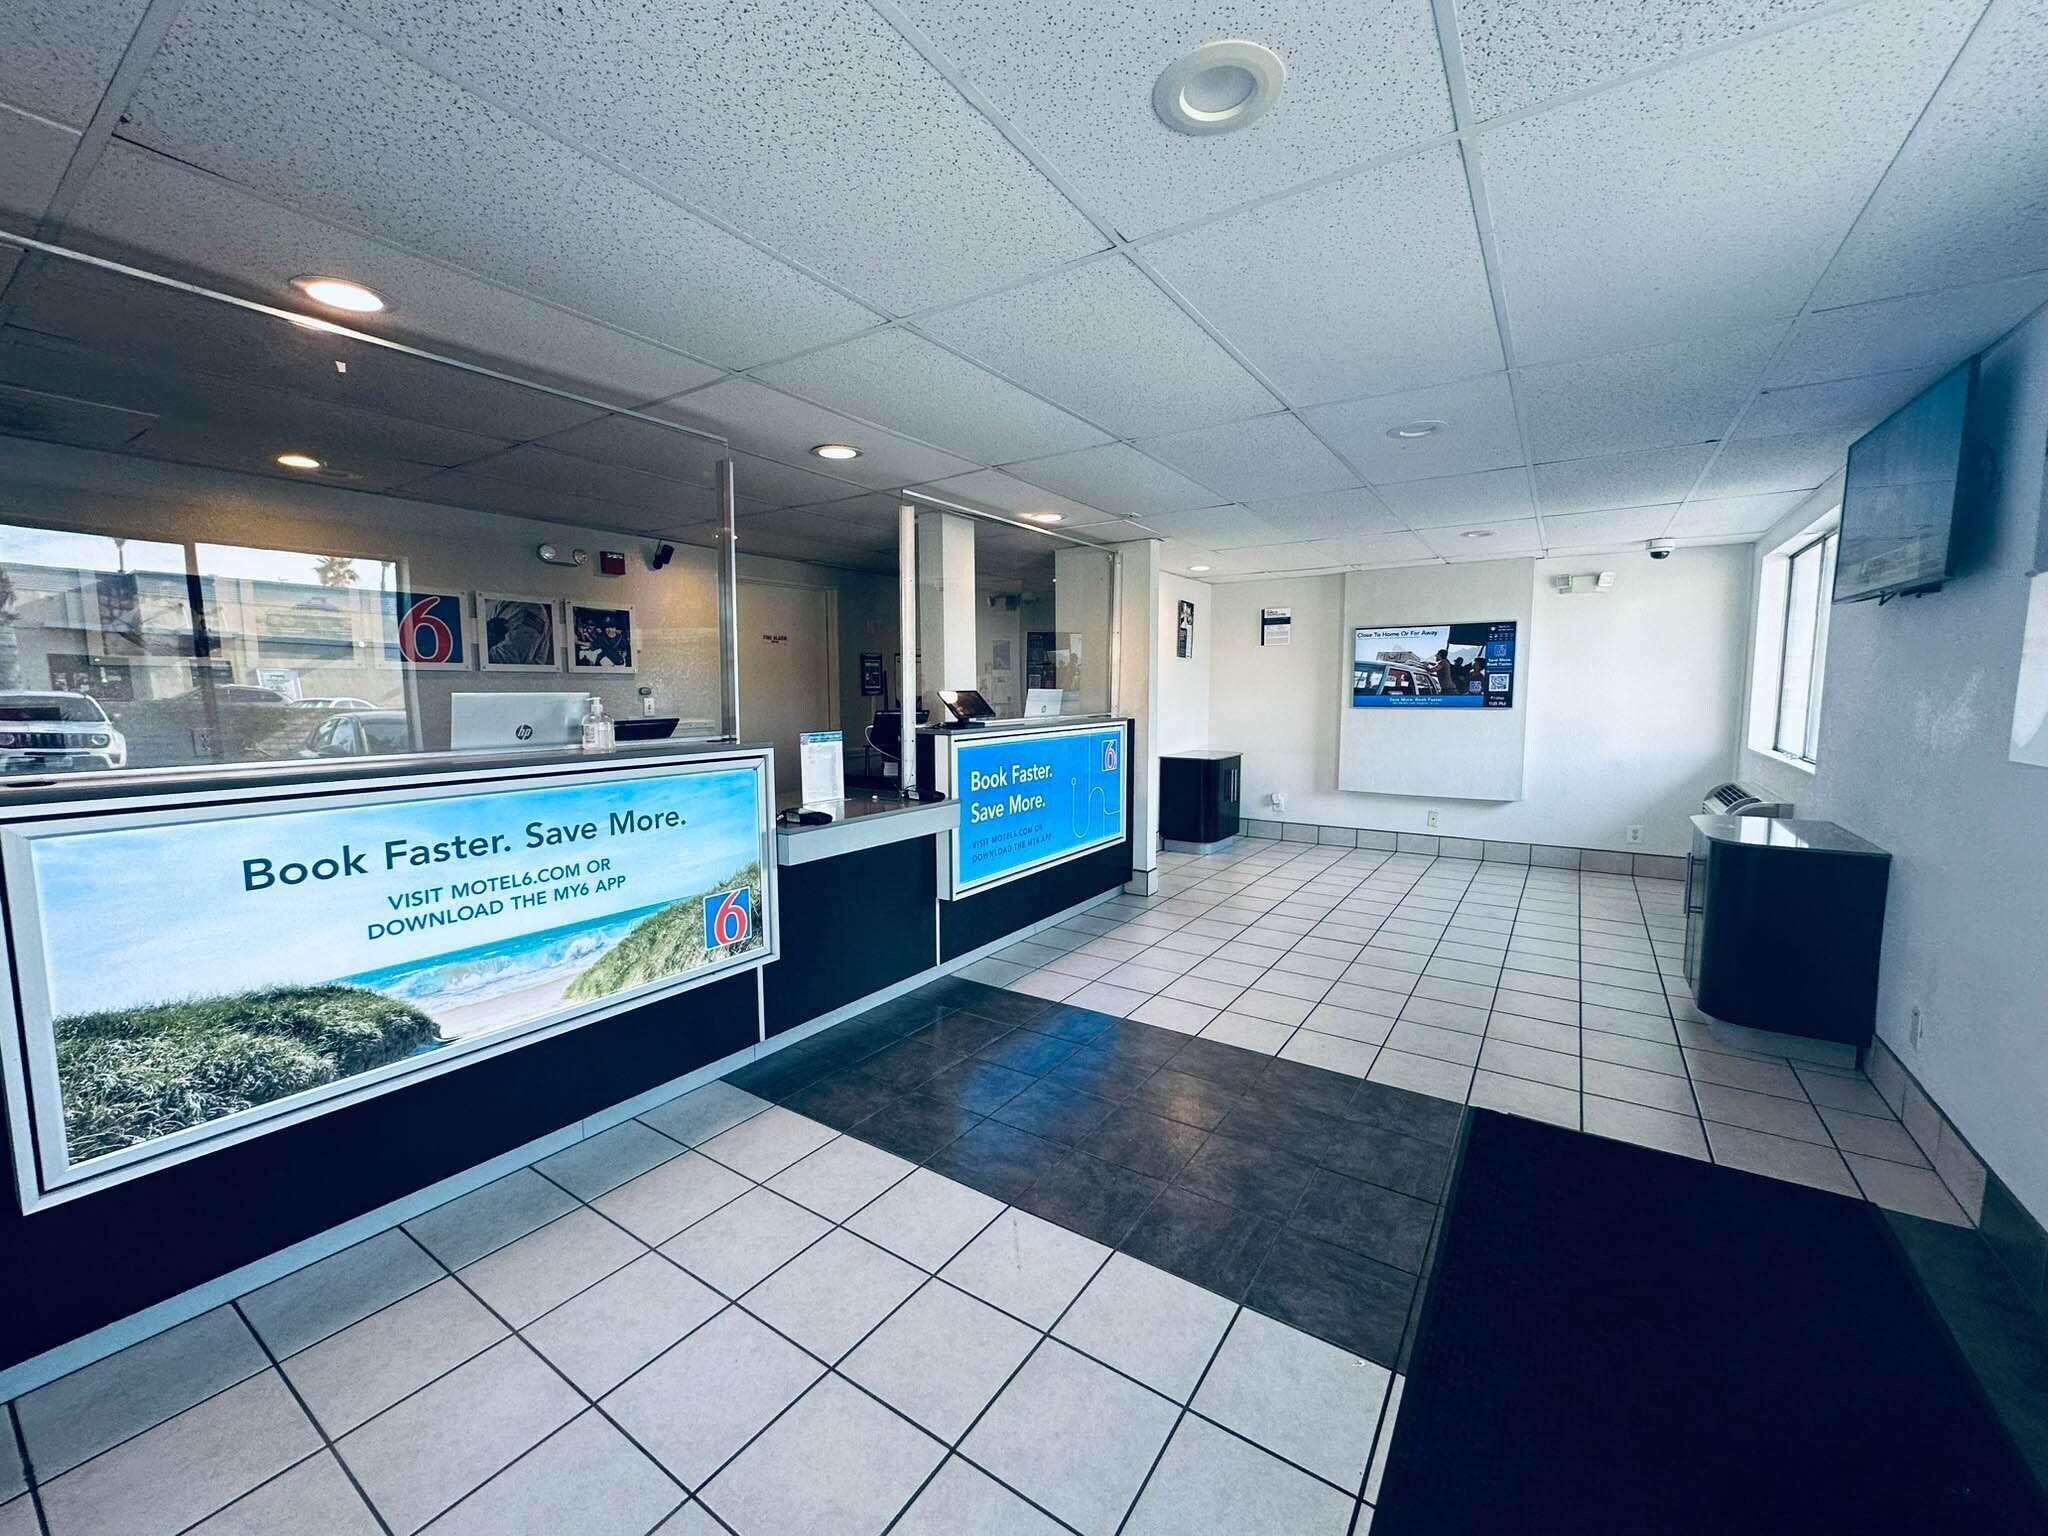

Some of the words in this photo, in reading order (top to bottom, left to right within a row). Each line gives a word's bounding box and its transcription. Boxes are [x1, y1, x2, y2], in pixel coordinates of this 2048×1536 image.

[516, 725, 532, 740] hp
[1104, 741, 1118, 770] 6
[971, 766, 1008, 792] Book
[1012, 764, 1053, 785] Faster.
[971, 802, 1005, 824] Save
[1009, 794, 1046, 815] More.
[243, 845, 369, 892] Book
[384, 834, 512, 870] Faster.
[526, 821, 598, 849] Save
[609, 809, 687, 836] More.
[972, 845, 1013, 863] DOWNLOAD
[1014, 841, 1026, 850] THE
[387, 887, 445, 911] VISIT
[451, 863, 582, 901] MOTEL6.COM
[586, 857, 612, 874] OR
[367, 899, 504, 940] DOWNLOAD
[510, 890, 548, 911] THE
[553, 880, 590, 902] MY6
[594, 874, 627, 895] APP
[713, 890, 748, 946] 6
